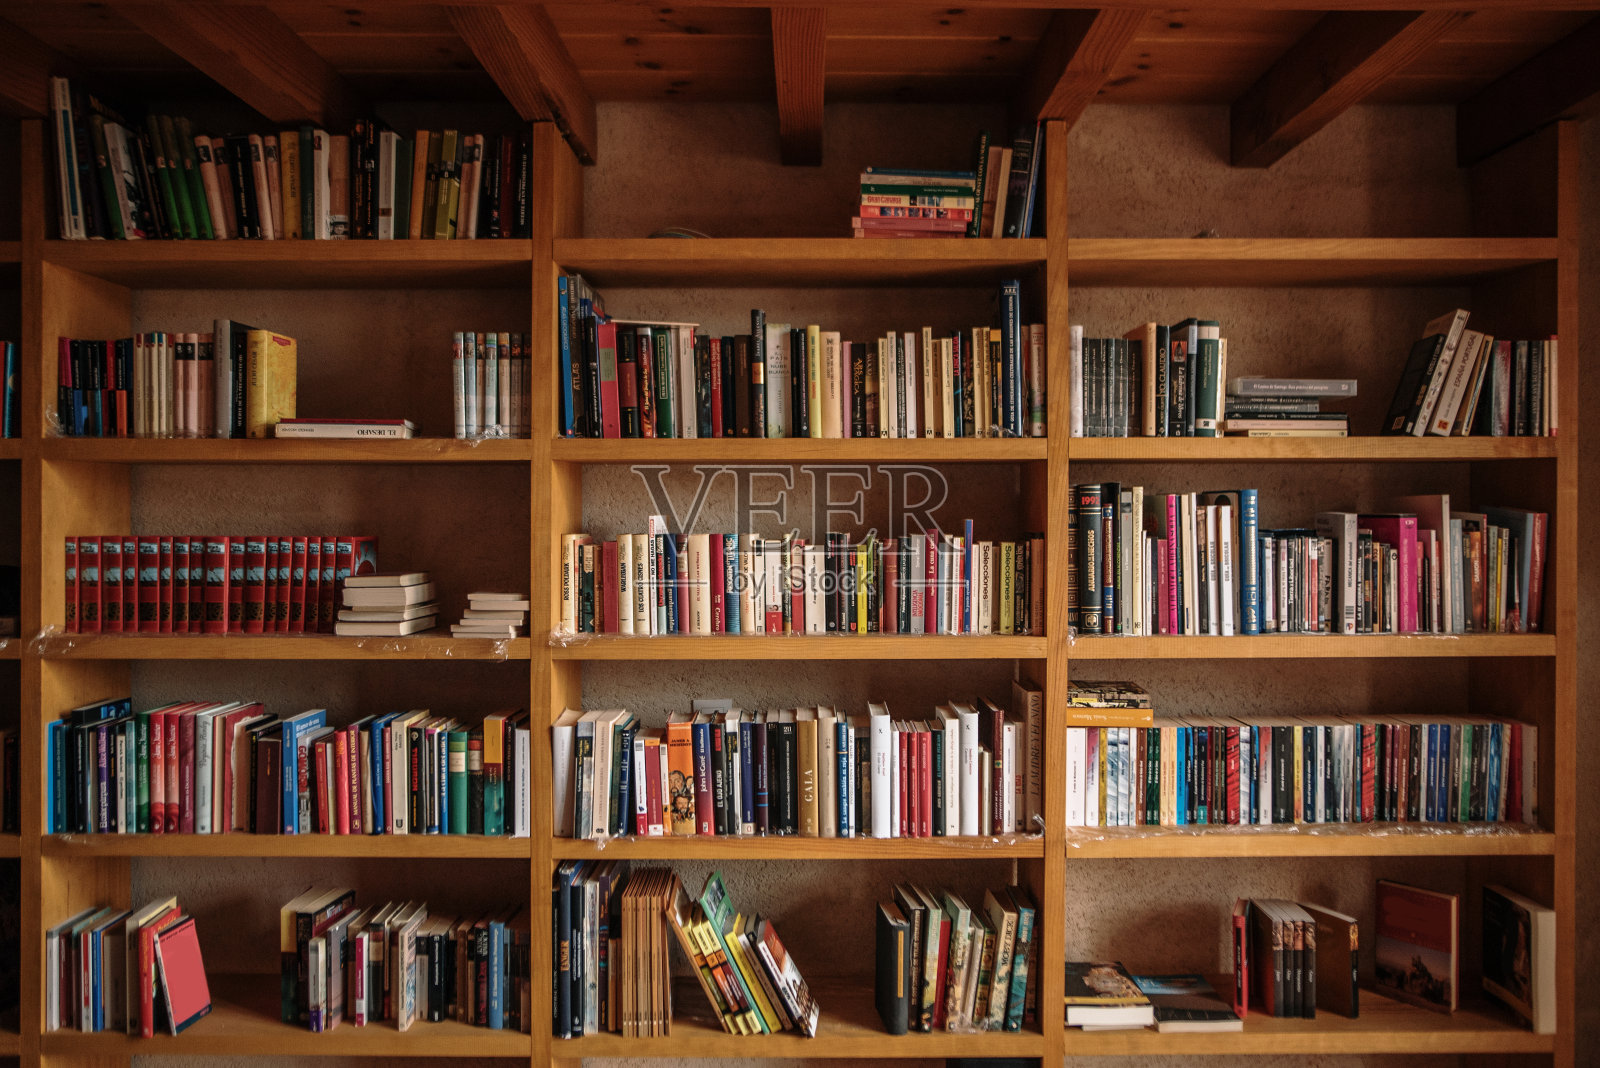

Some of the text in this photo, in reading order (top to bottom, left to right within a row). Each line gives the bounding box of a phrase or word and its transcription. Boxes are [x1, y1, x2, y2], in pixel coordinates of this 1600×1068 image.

[1158, 347, 1167, 381] CLAUDIO
[1453, 334, 1477, 388] ESPAÑA PORTUGAL
[572, 361, 581, 391] ATLAS
[1088, 529, 1096, 555] HECHOS
[1003, 544, 1011, 600] Selecciones
[1030, 722, 1041, 736] EL
[350, 753, 358, 761] DE
[1030, 746, 1041, 781] MADRE
[352, 784, 359, 793] DE
[699, 777, 708, 792] John
[804, 769, 814, 802] GALA
[1030, 780, 1041, 797] LA
[716, 800, 724, 808] EL
[841, 816, 848, 824] La
[1001, 942, 1010, 967] MOBY
